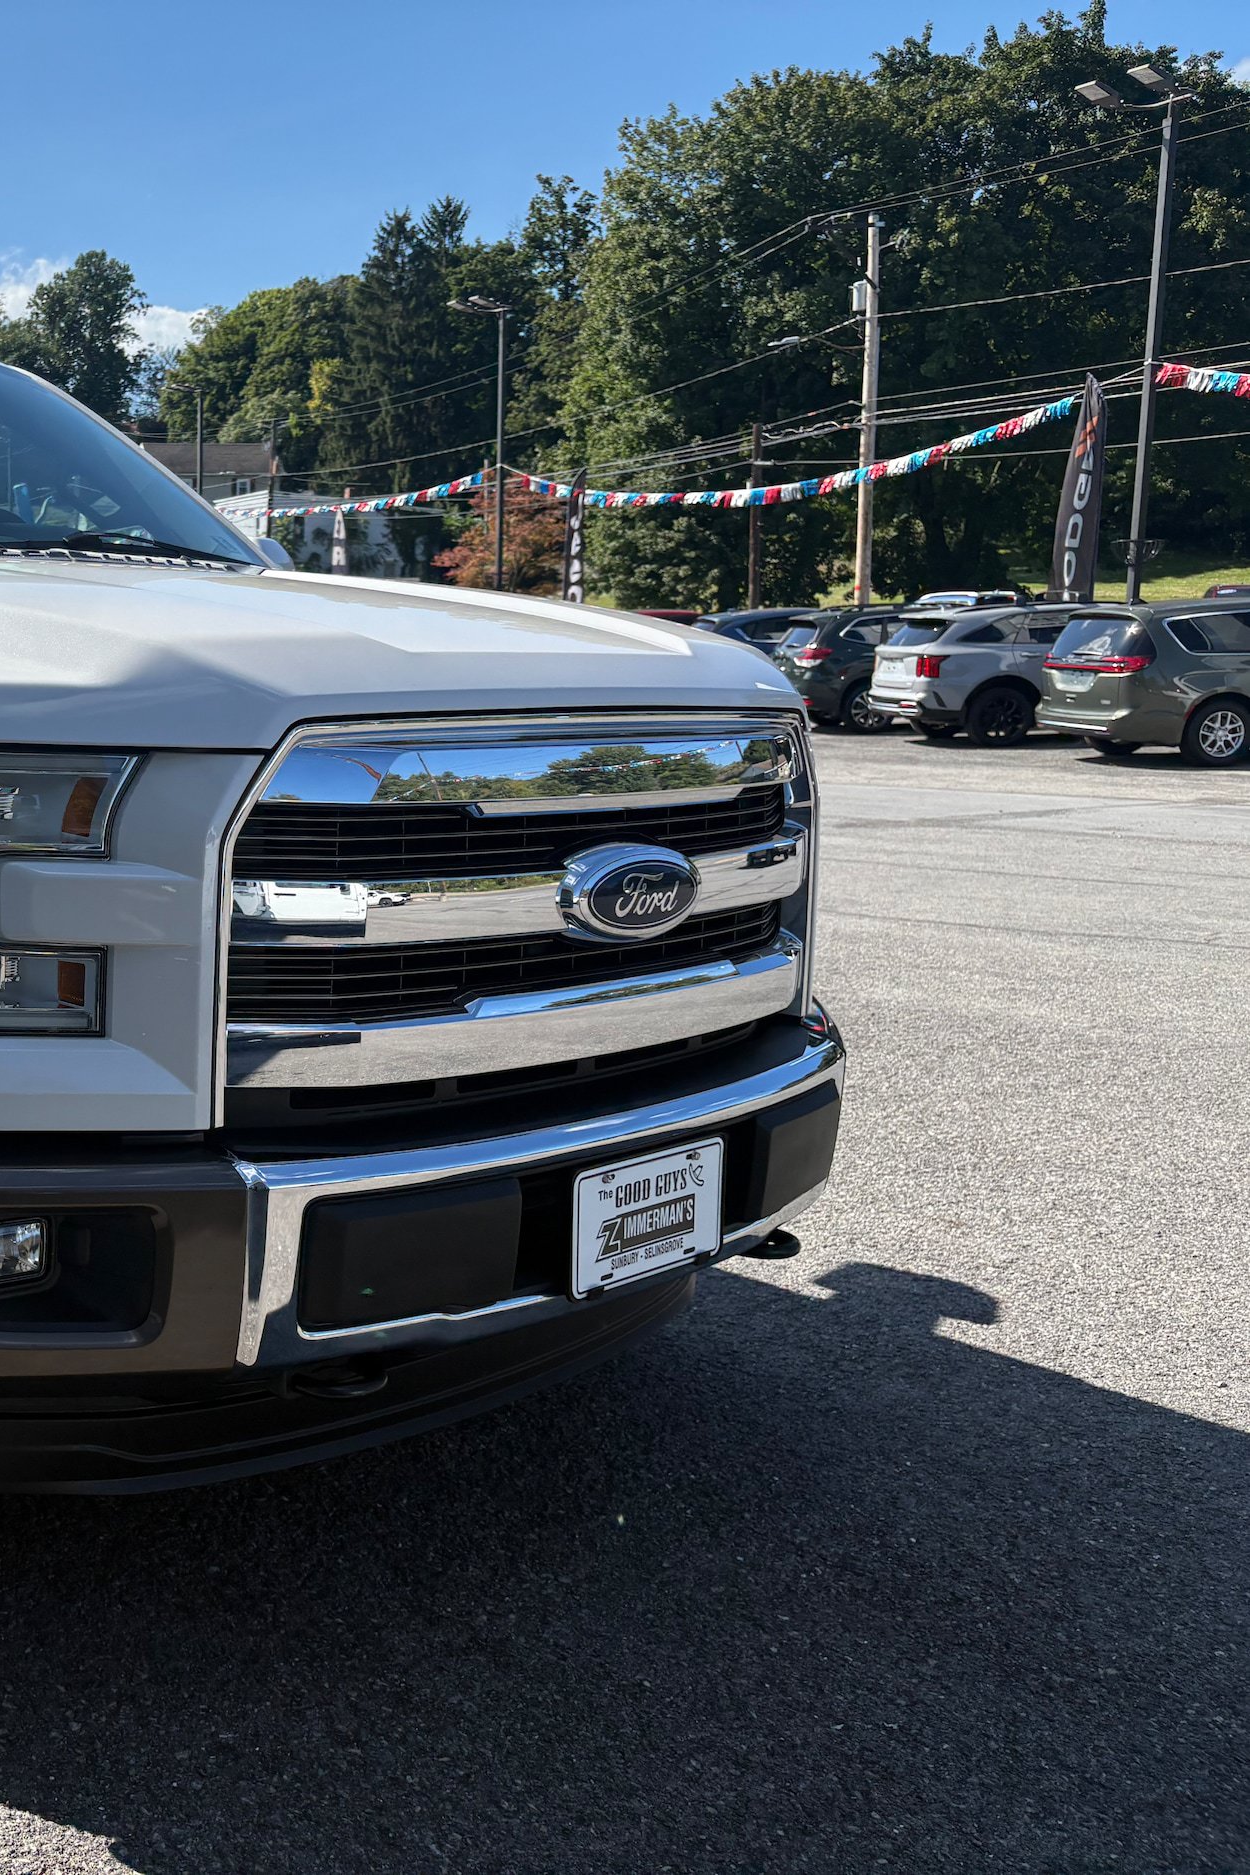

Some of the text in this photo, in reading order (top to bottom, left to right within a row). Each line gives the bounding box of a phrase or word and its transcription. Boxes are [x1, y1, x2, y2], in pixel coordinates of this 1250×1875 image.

[614, 872, 680, 918] Ford
[598, 1167, 688, 1208] The GOOD GUYS
[595, 1198, 694, 1263] ZIMMERMAN'S
[610, 1251, 639, 1271] SUNBURY
[644, 1237, 684, 1260] SELINSGROVE
